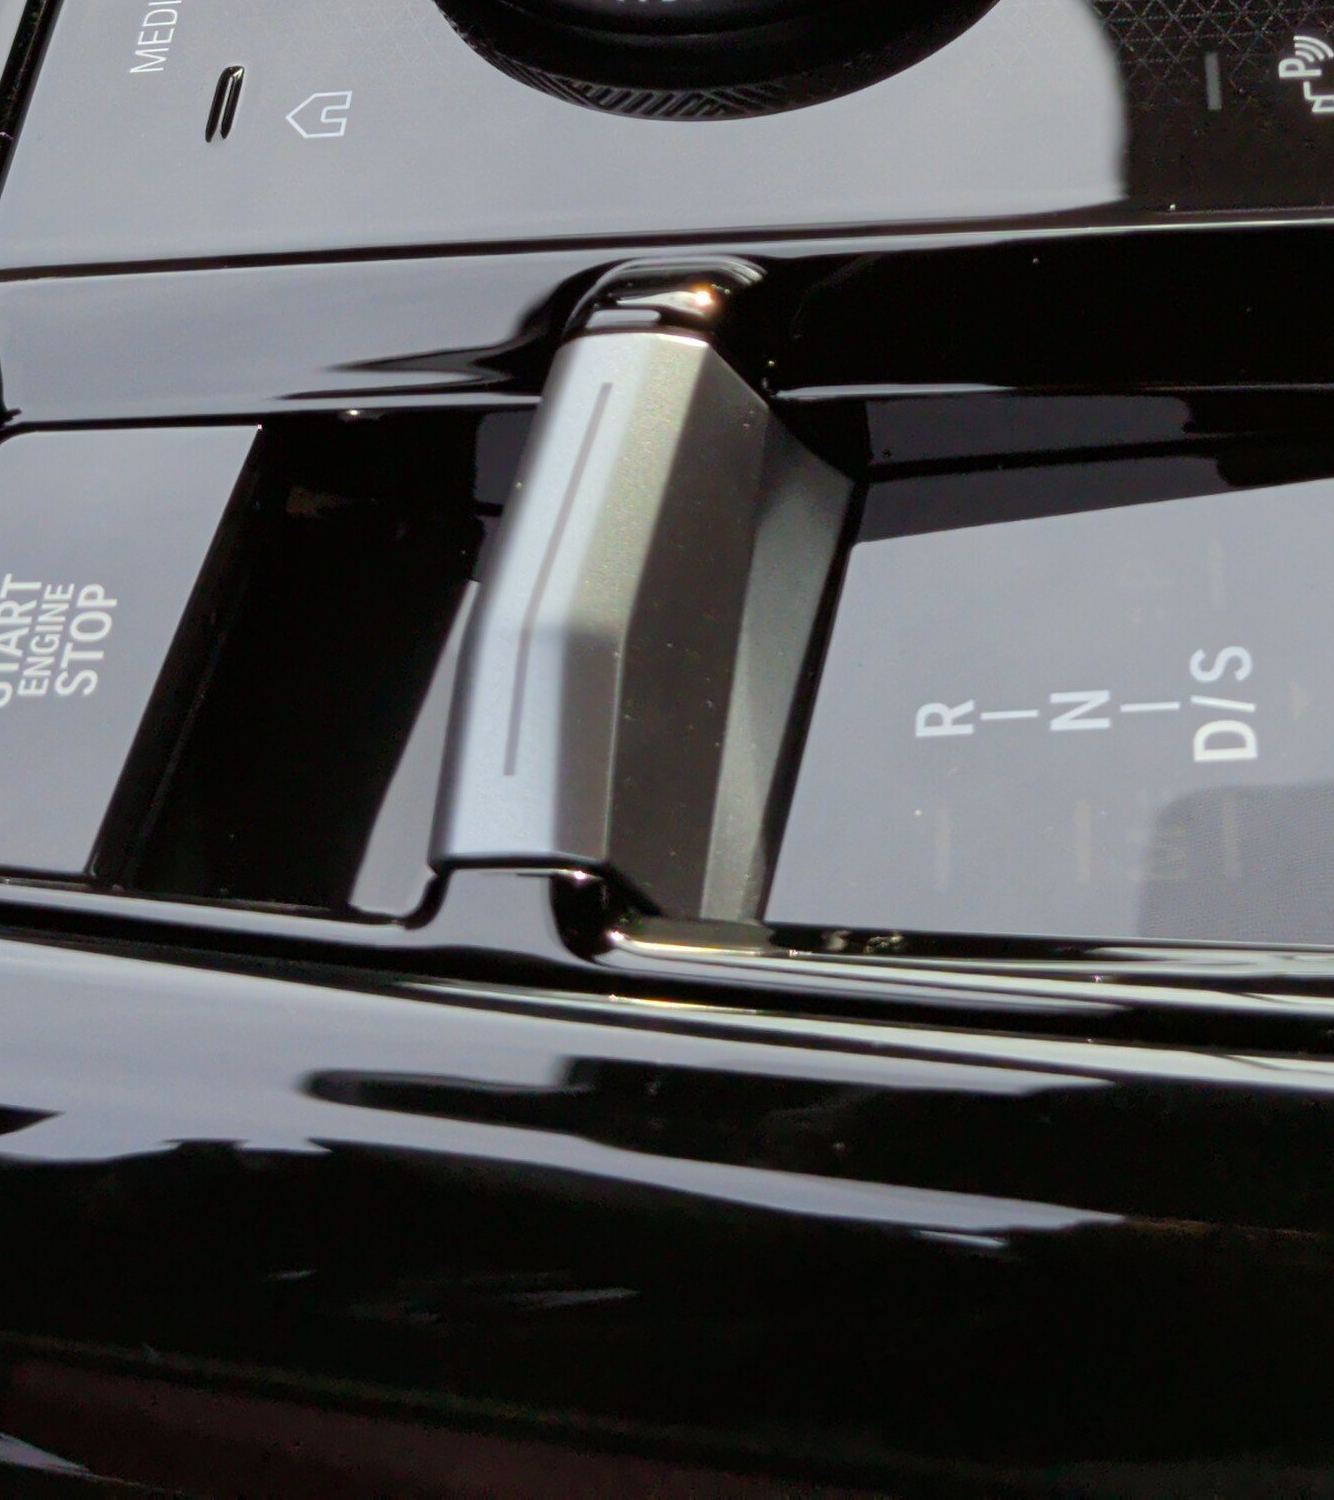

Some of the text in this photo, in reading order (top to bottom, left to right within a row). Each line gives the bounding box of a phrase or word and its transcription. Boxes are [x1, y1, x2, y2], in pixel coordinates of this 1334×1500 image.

[17, 584, 75, 697] ENGINE
[55, 584, 117, 697] STOP
[915, 699, 974, 738] R
[1049, 690, 1111, 731] N
[1190, 645, 1258, 763] D/S
